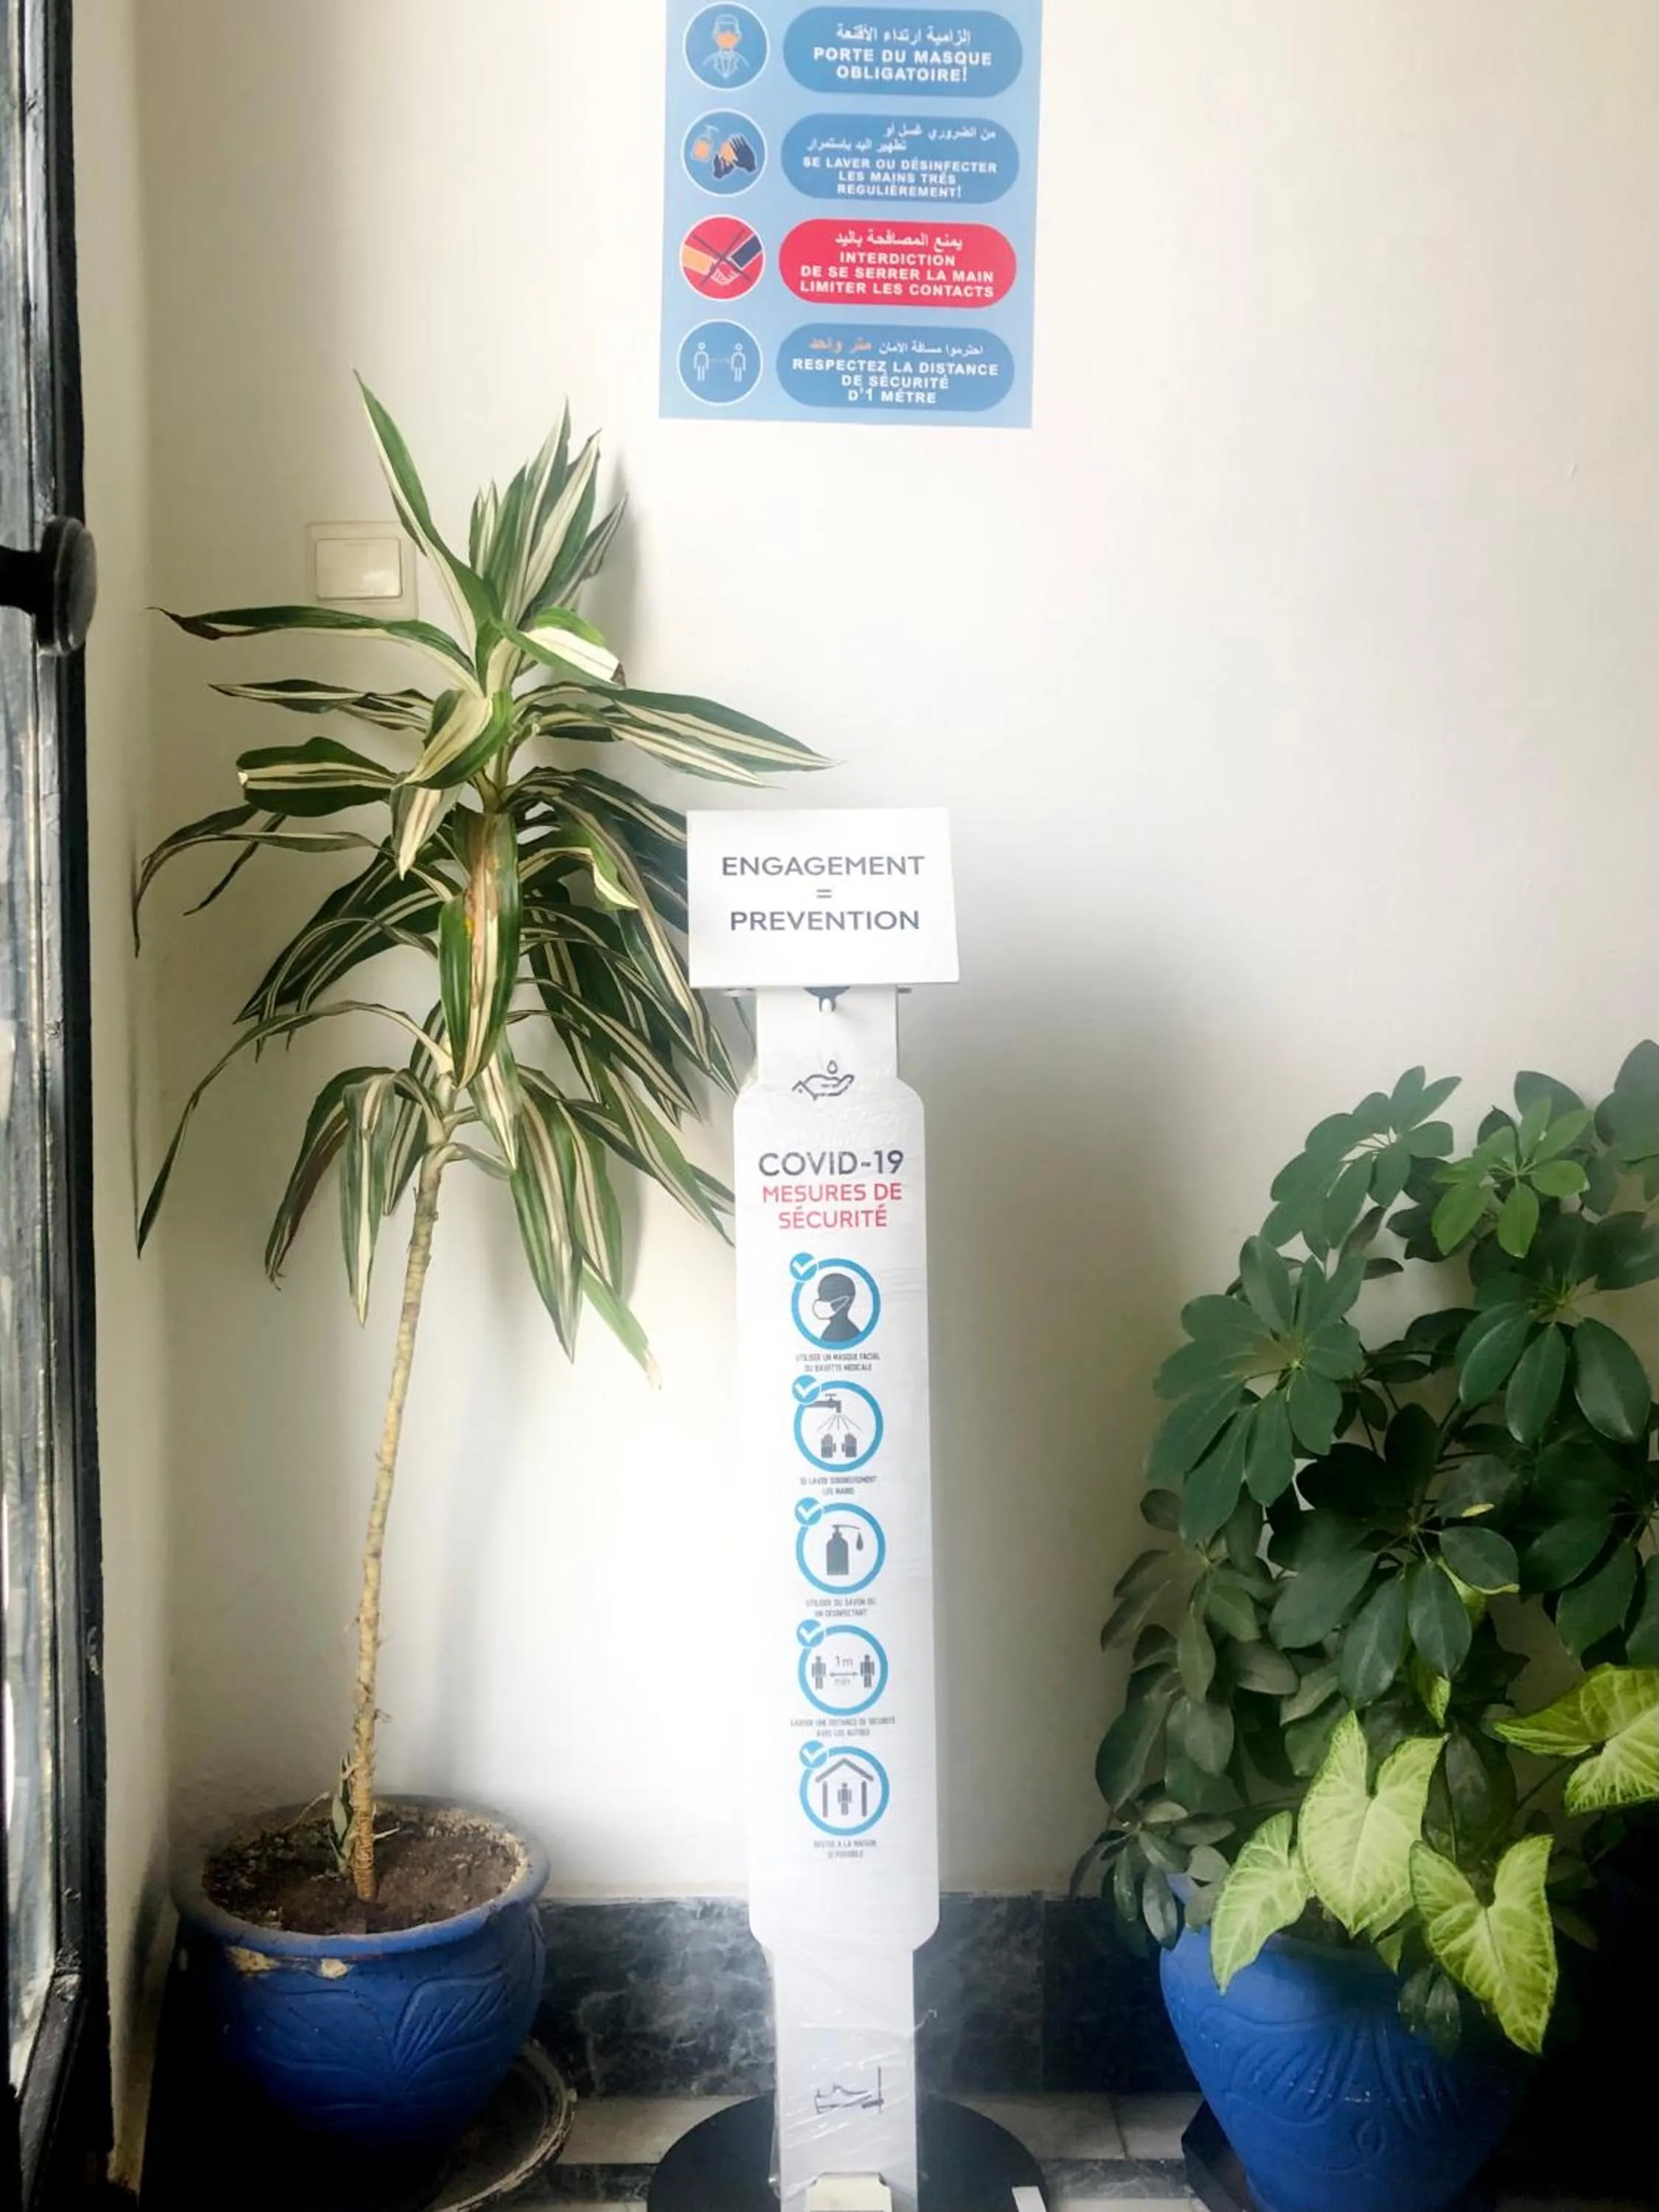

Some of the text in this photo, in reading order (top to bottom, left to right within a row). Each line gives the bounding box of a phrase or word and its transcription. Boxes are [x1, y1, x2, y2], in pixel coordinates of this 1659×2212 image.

[813, 46, 992, 66] PORTE DU MASQUE
[836, 65, 967, 83] OBLIGATOIRE!
[826, 156, 870, 170] LAVER
[875, 159, 896, 170] OU
[838, 170, 865, 182] LES
[869, 172, 916, 184] MAINS
[840, 251, 956, 267] INTERDICTION
[801, 265, 993, 283] DE SE SERRER LA MAIN
[800, 281, 994, 298] LIMITER LES CONTACTS
[793, 358, 999, 376] RESPECTEZ LA DISTANCE
[841, 373, 949, 389] DE SÉCURITÉ
[722, 855, 925, 876] ENGAGEMENT
[731, 910, 919, 931] PREVENTION
[758, 1150, 904, 1177] COVID-19
[762, 1182, 902, 1204] MESURES DE
[779, 1203, 888, 1229] SÉCURITÉ
